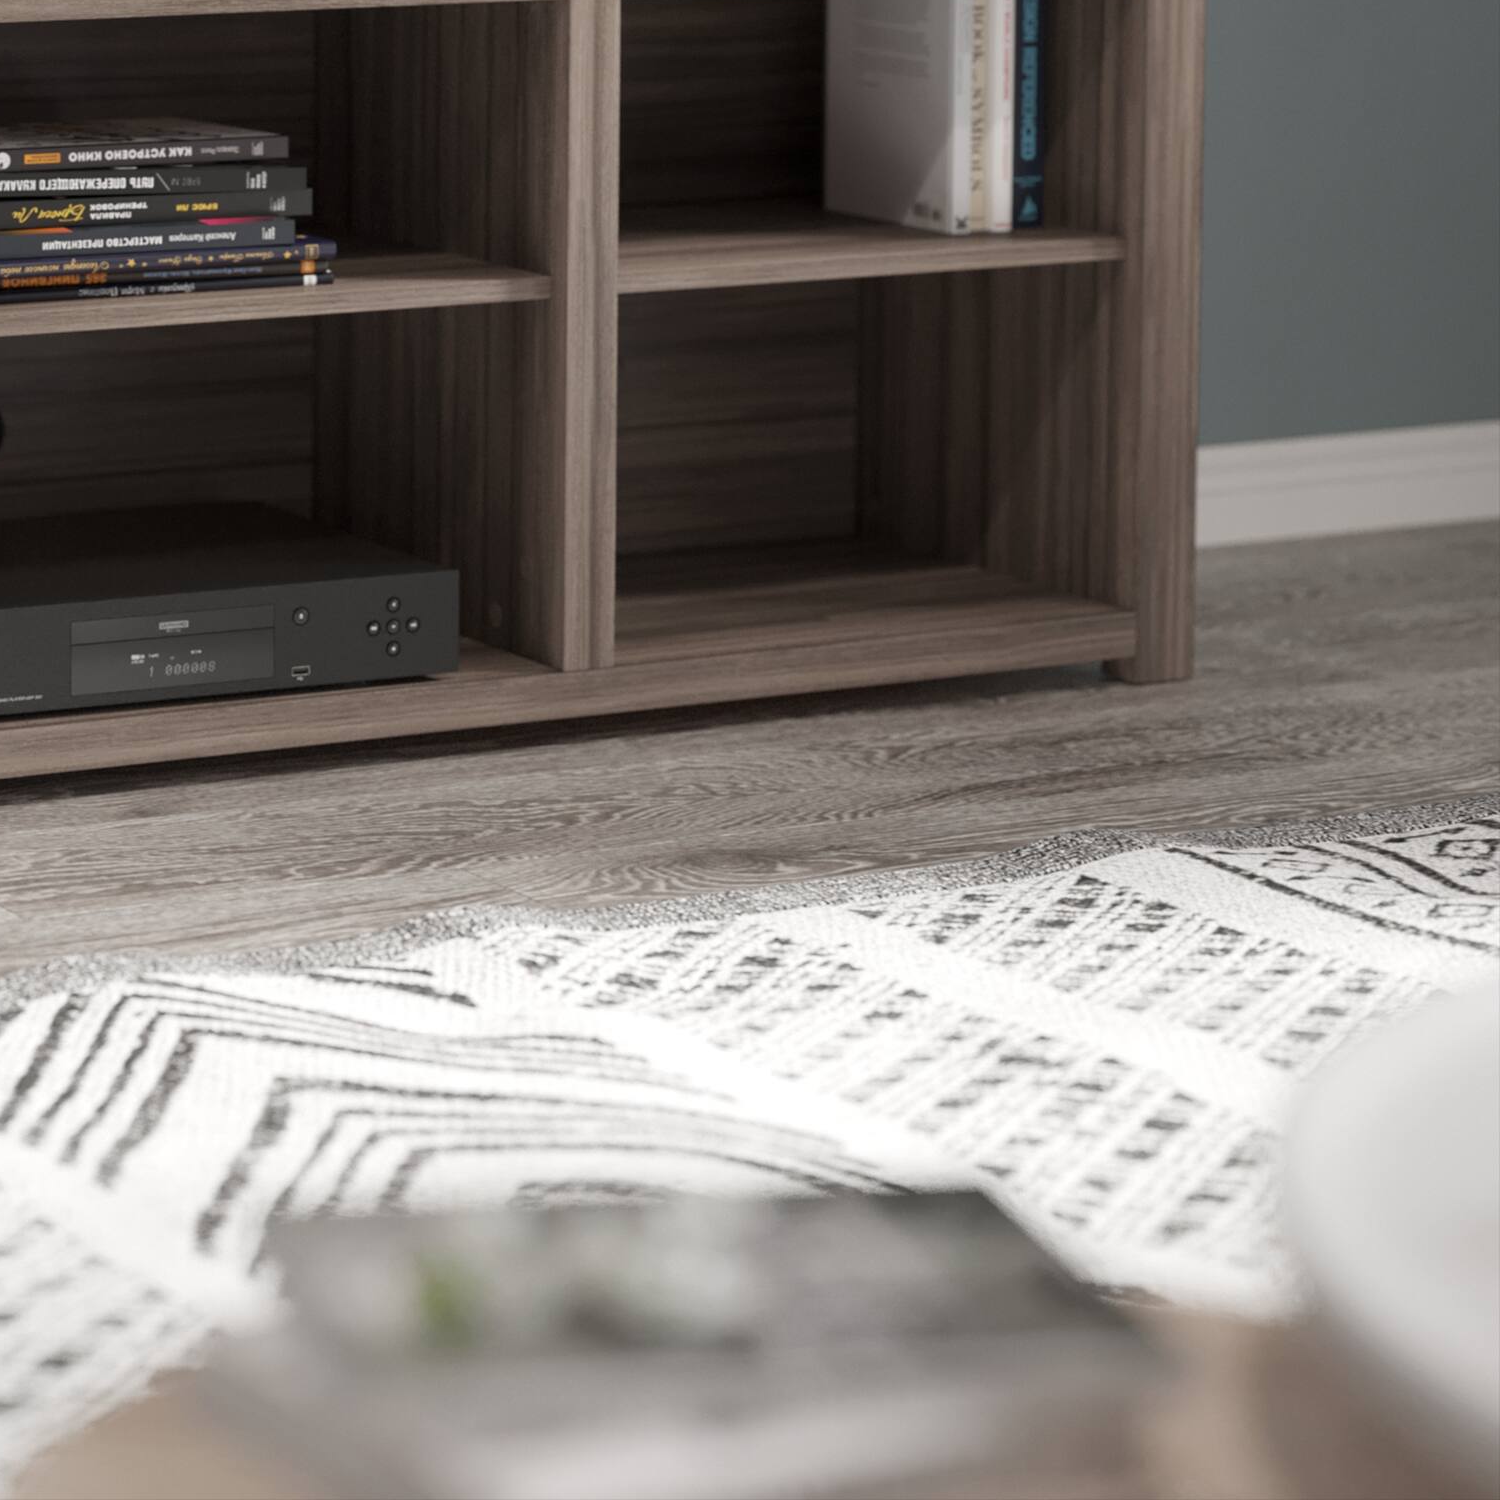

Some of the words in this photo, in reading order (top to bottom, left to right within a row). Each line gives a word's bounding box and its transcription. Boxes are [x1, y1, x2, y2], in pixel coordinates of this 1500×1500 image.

[68, 151, 103, 163] КИНО
[104, 147, 167, 161] УСТРОЕНО
[168, 146, 193, 157] КАК
[38, 176, 127, 191] ОПЕРЕЖАЮЩЕГО
[129, 176, 155, 189] ПУТЬ
[89, 201, 148, 212] ТРЕНИРОВОК
[89, 210, 132, 221] ПРАВИЛА
[41, 237, 104, 251] ПРЕЗЕНТАЦИИ
[106, 234, 163, 248] МАСТЕРСТВО
